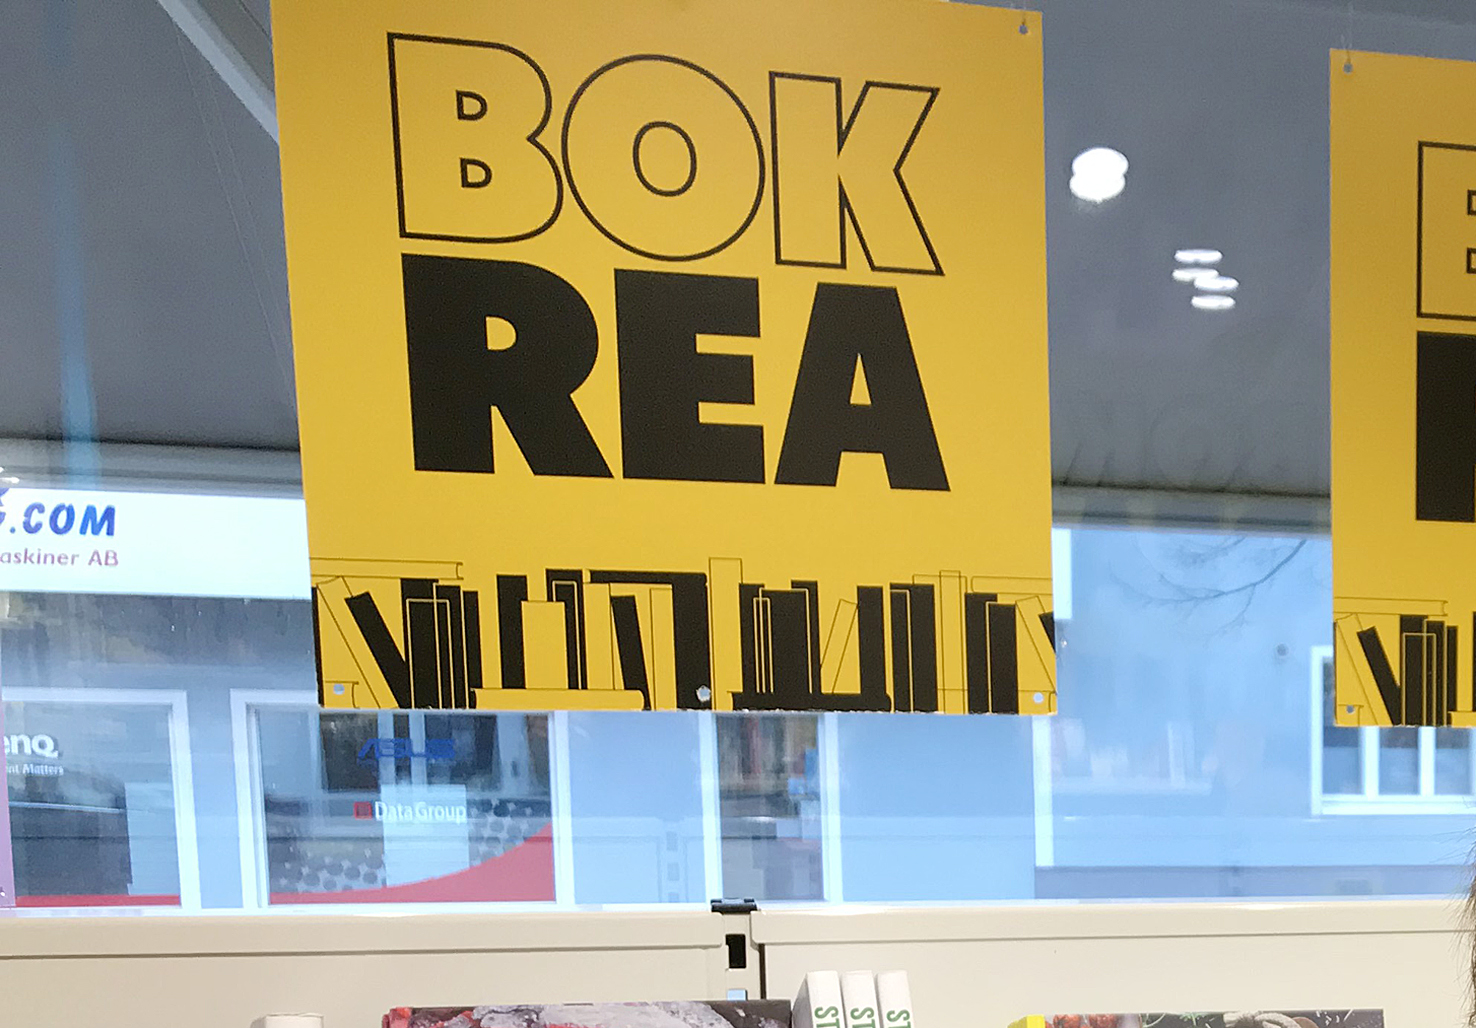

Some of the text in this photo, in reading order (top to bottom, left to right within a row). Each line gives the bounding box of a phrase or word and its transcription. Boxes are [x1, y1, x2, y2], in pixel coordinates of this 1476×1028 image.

[387, 31, 945, 276] BOK
[401, 253, 950, 492] REA
[0, 499, 116, 536] .COM
[88, 549, 119, 566] AB
